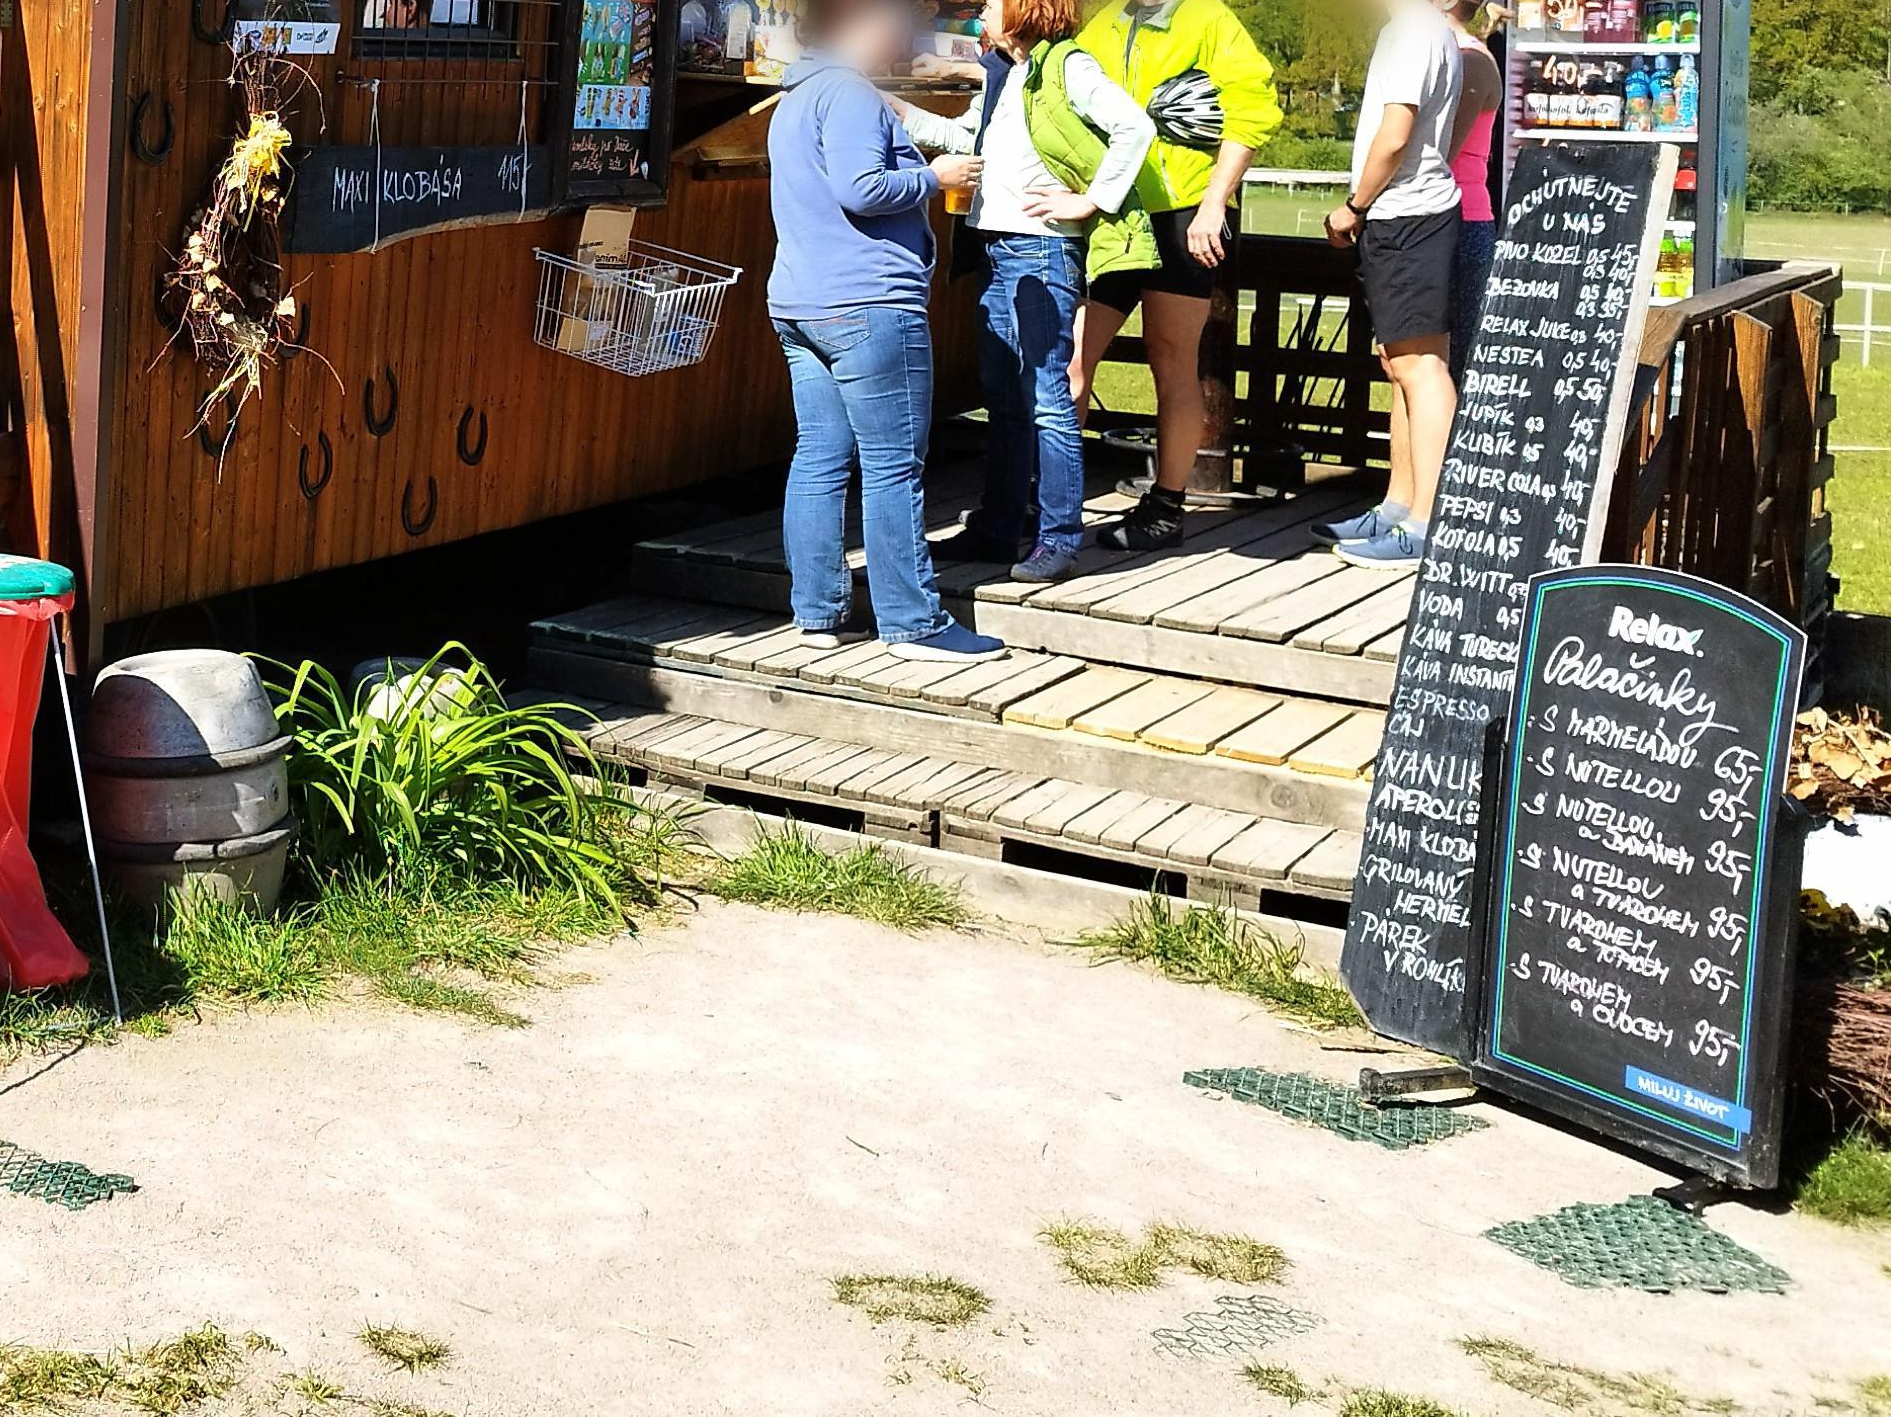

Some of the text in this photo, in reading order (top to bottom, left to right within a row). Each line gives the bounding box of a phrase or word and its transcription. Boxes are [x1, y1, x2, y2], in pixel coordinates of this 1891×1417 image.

[332, 166, 370, 214] MAXI
[383, 154, 462, 207] KLOBÁSA
[1507, 175, 1638, 225] OCHUTNEJTE
[1542, 201, 1606, 235] U NÁS
[1494, 239, 1529, 261] PIVO
[1532, 241, 1582, 265] KOZEL
[1485, 276, 1560, 300] BEZOVKA
[1479, 314, 1530, 337] RELAX
[1473, 343, 1545, 369] NESTEA
[1462, 369, 1533, 398] BIRELL
[1459, 401, 1515, 426] JUPÍK
[1453, 430, 1517, 457] KUBÍK
[1444, 458, 1506, 493] RIVER
[1507, 470, 1541, 496] COLA
[1438, 494, 1495, 525] PEPSI
[1431, 521, 1495, 556] KOFOLA
[1418, 587, 1464, 621] VODA
[1409, 619, 1453, 655] KÁVA
[1401, 651, 1441, 682] KÁVA
[1394, 685, 1490, 721] ESPRESSO
[1543, 635, 1740, 748] Palačinky
[1537, 704, 1559, 733] S
[1566, 707, 1698, 769] MARMELÁDOU
[1535, 746, 1555, 777] S
[1565, 752, 1682, 804] NUTELLOU
[1556, 793, 1655, 840] NUTELLOU
[1369, 817, 1411, 854] MAXI
[1362, 854, 1474, 900] GRILOVANÝ
[1552, 845, 1665, 900] NUTELLOU
[1518, 894, 1659, 957] S TVAROHEM
[1592, 886, 1700, 938] TVAROHEM
[1359, 907, 1431, 955] PÁREK
[1384, 950, 1399, 973] V
[1538, 959, 1633, 1014] TVAROHEM
[1592, 1003, 1674, 1048] OVOCEM
[1637, 1075, 1730, 1120] MILUJ ŽIVOT
